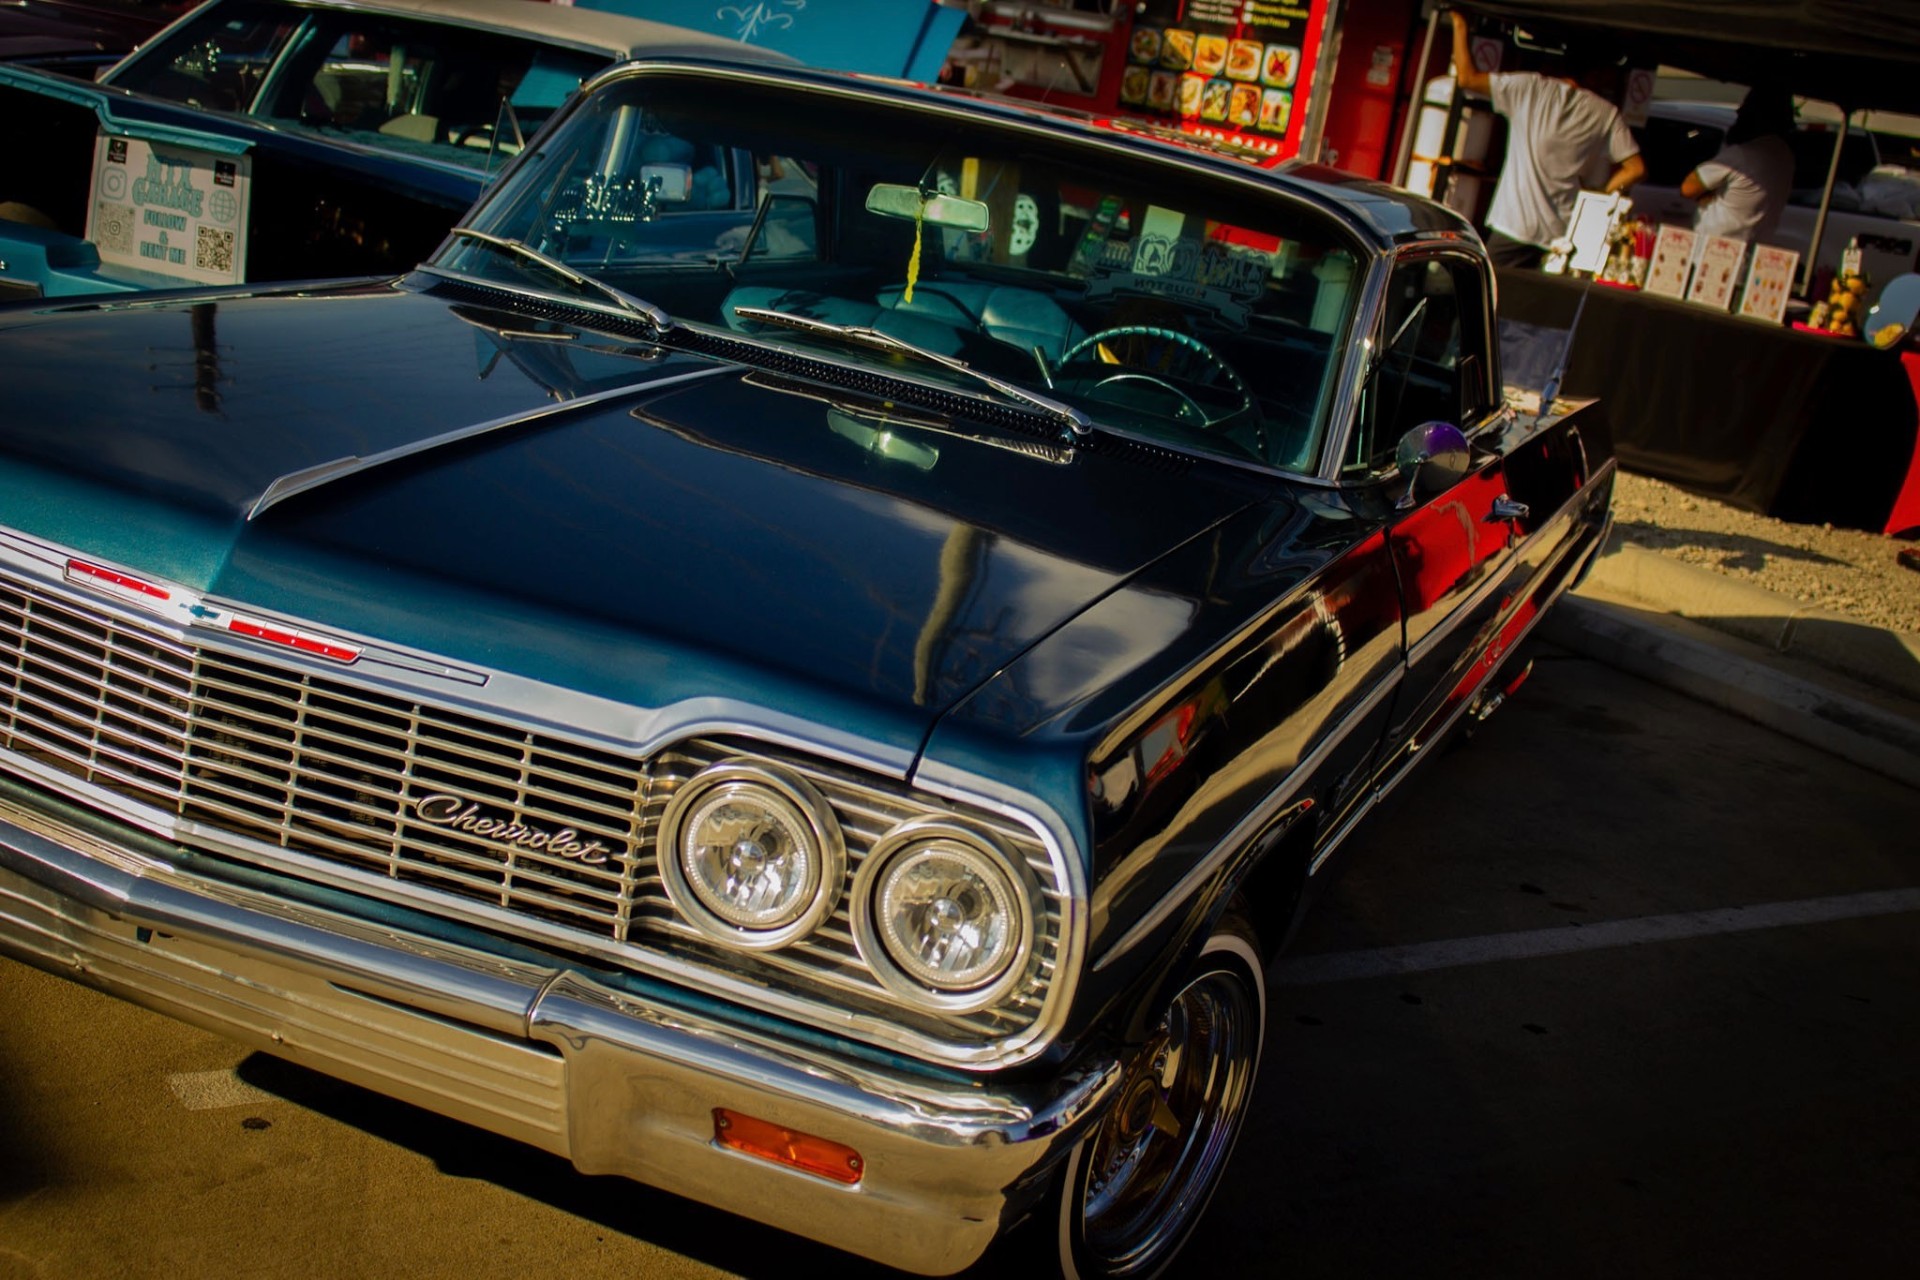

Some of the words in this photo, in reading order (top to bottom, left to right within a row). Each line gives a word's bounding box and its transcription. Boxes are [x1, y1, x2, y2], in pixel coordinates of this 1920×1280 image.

[133, 178, 203, 217] GARAGE
[144, 209, 186, 231] FOLLOW
[141, 241, 168, 260] RENT
[169, 247, 185, 264] ME
[416, 794, 609, 863] Chevrolet
